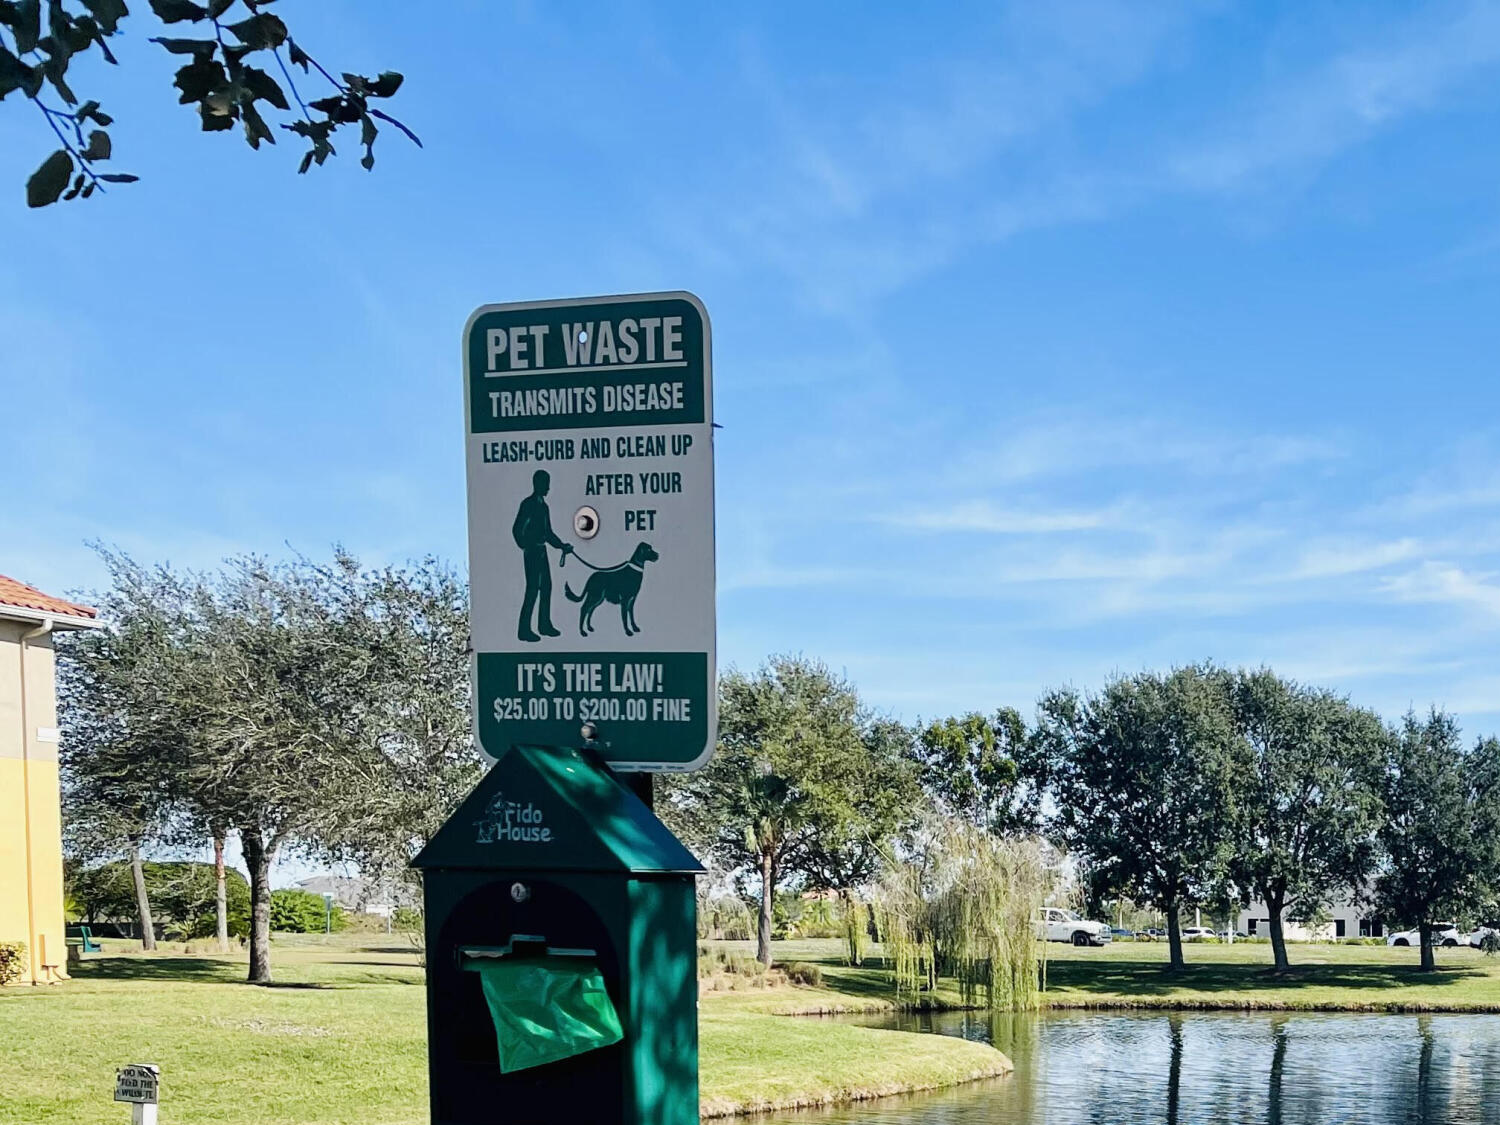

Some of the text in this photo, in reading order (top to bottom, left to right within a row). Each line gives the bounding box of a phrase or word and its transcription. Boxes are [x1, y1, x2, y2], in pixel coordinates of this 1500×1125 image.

[487, 316, 684, 371] PET WASTE
[488, 382, 684, 418] TRANSMITS DISEASE
[483, 434, 693, 463] LEASH-CURB AND CLEAN UP
[585, 472, 682, 495] AFTER YOUR
[624, 510, 657, 531] PET
[517, 663, 664, 692] IT'S THE LAW!
[493, 697, 691, 722] $25.00 TO $200.00 FINE
[505, 802, 542, 823] Fido
[496, 821, 551, 842] House
[138, 1069, 151, 1078] NO
